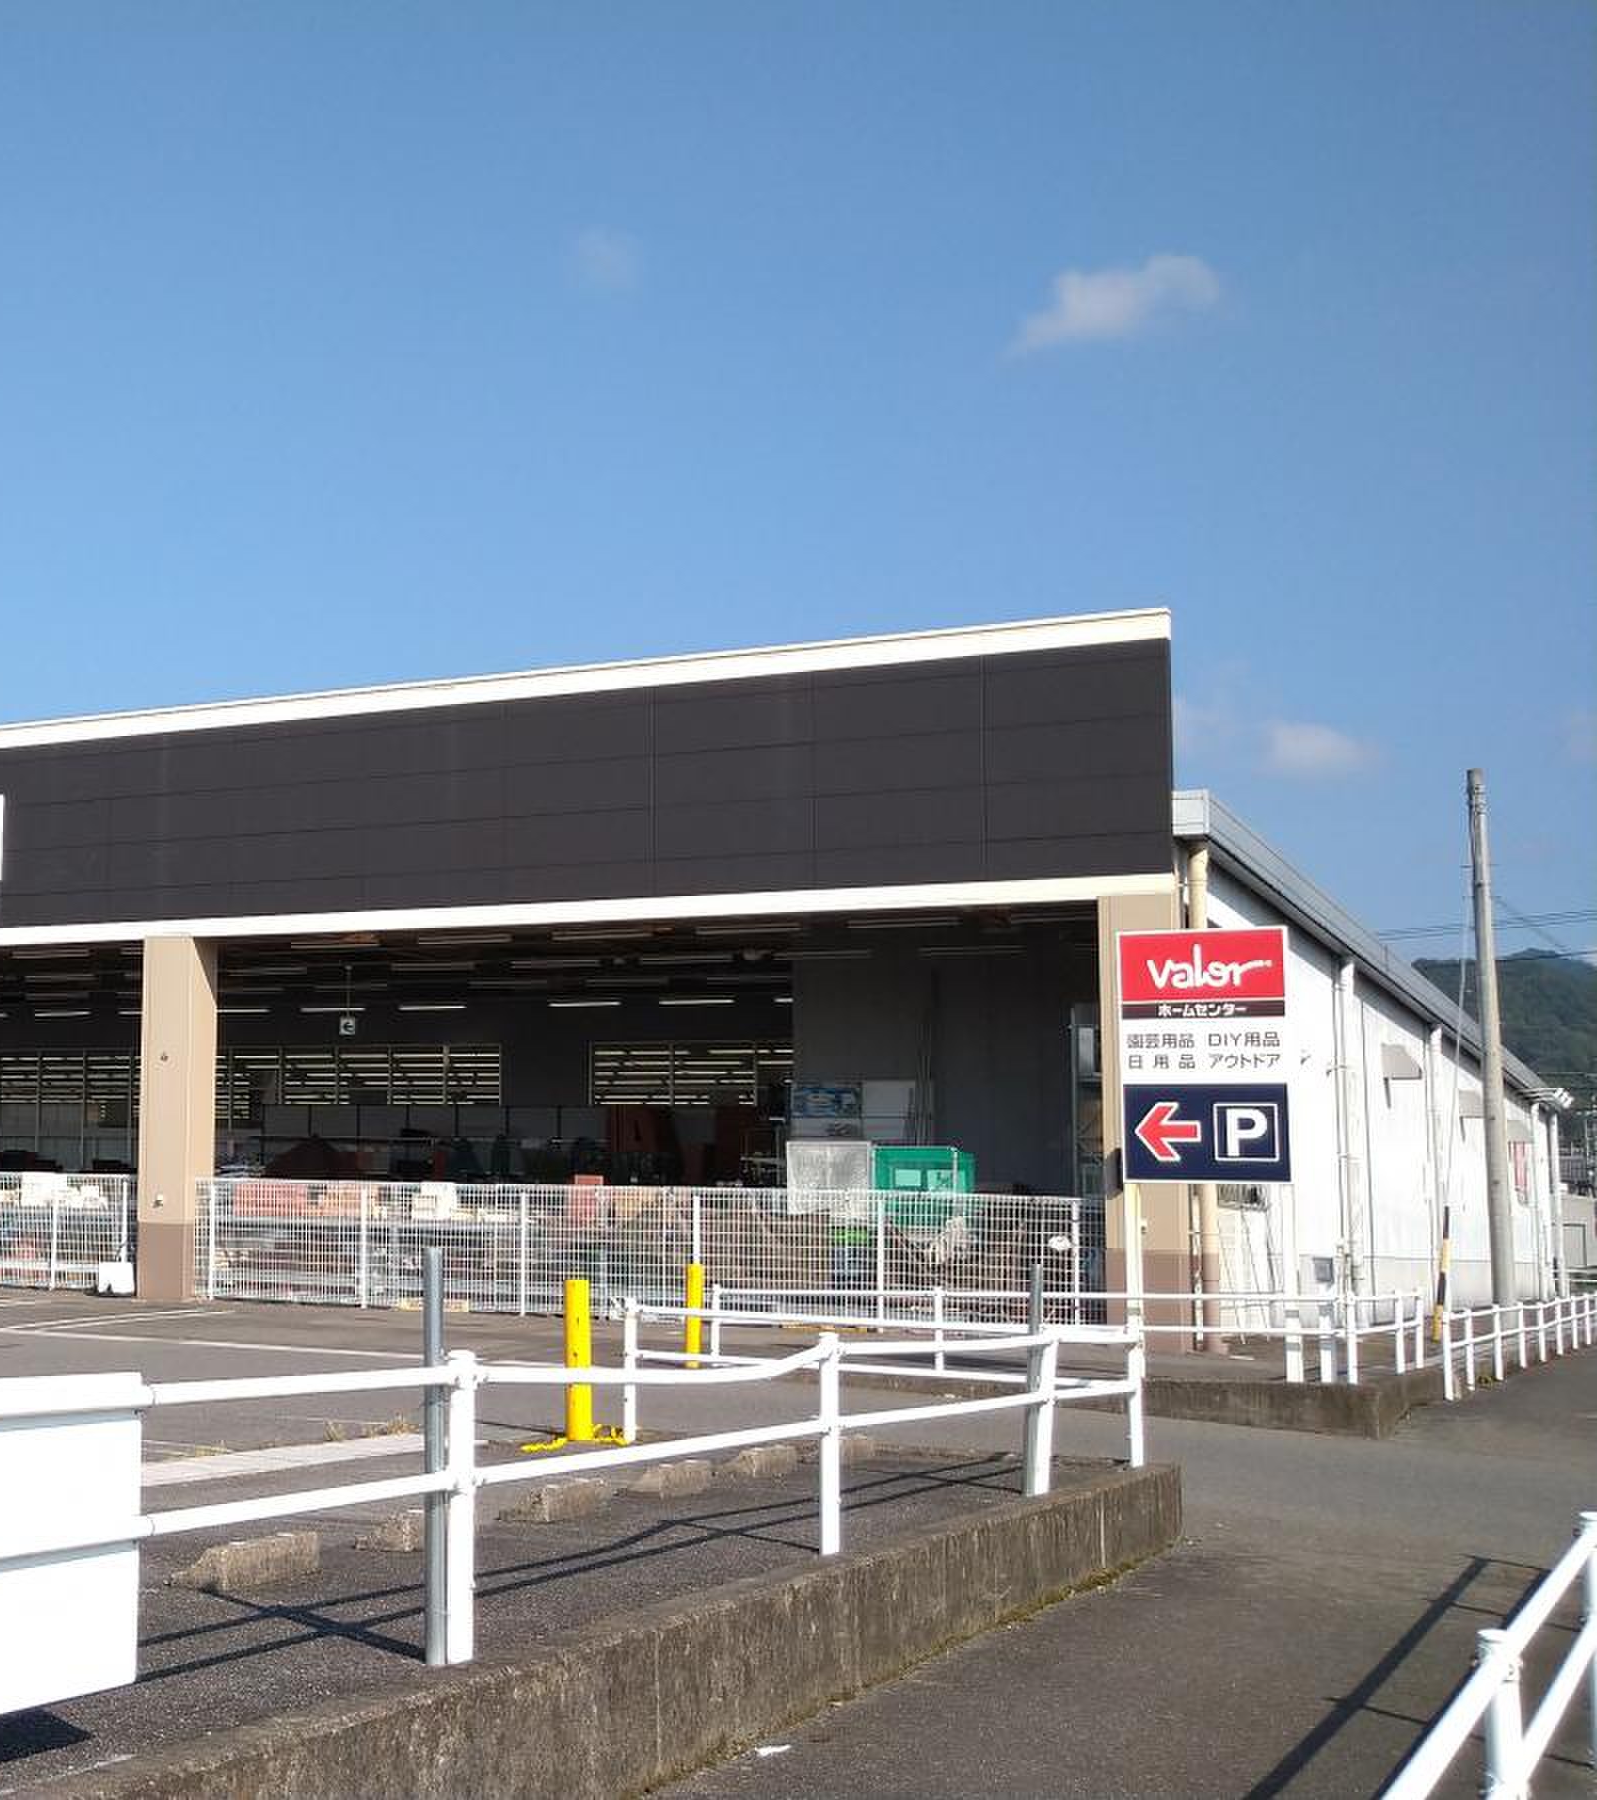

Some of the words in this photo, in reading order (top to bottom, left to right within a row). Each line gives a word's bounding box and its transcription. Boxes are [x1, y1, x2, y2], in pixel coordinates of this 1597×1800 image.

[1157, 1003, 1247, 1018] ホームセンター
[1127, 1033, 1195, 1049] 園芸用品
[1208, 1031, 1281, 1048] DIY用品
[1208, 1053, 1281, 1070] アウトドア
[1225, 1108, 1269, 1157] P
